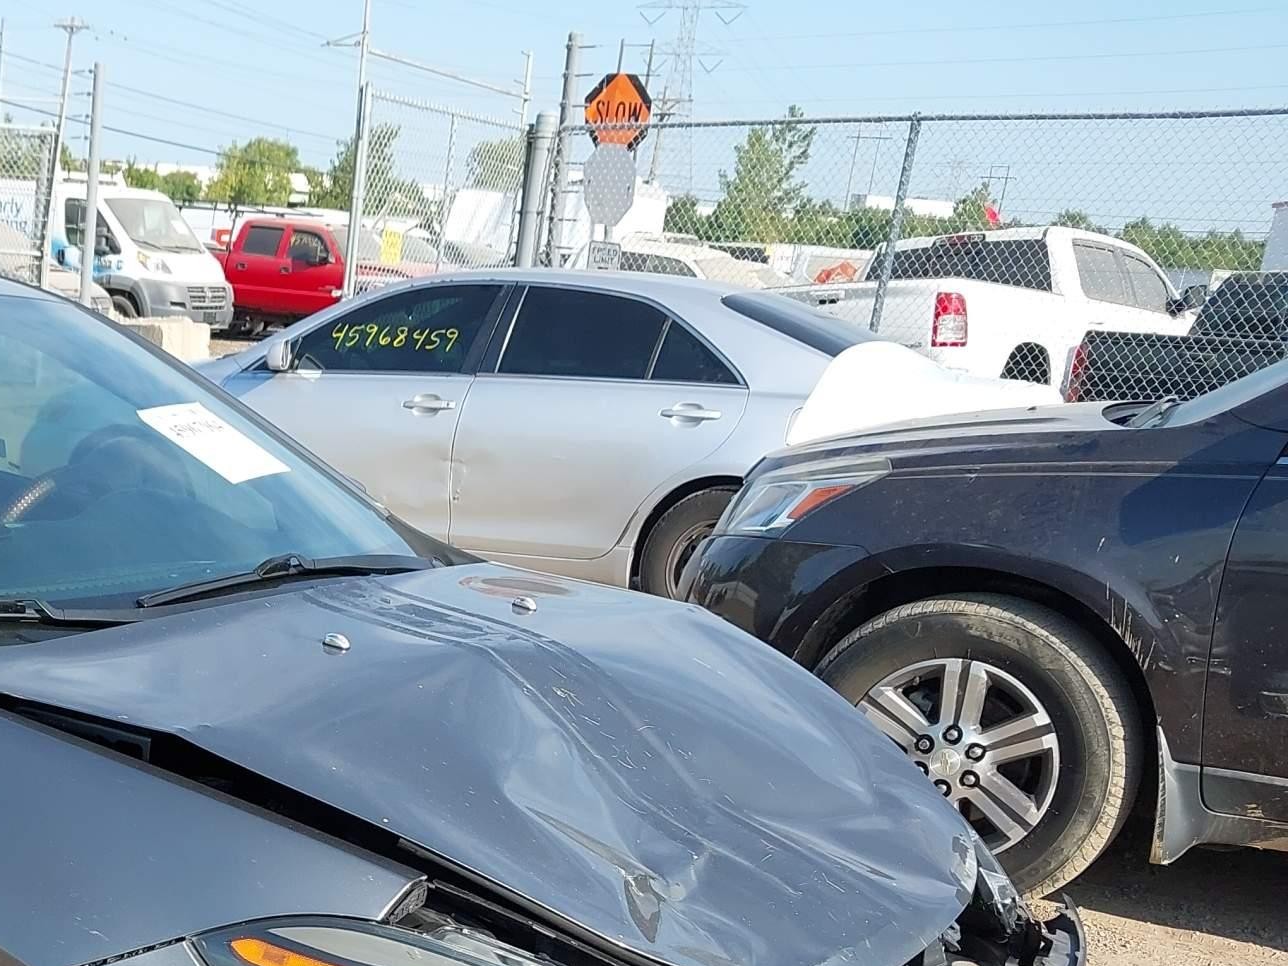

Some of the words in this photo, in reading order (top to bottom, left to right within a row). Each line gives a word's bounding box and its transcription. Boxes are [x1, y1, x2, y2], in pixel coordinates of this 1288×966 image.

[595, 99, 643, 125] SLOW
[591, 246, 618, 257] SPEED
[593, 255, 616, 265] LIMIT
[332, 322, 459, 352] 45968459
